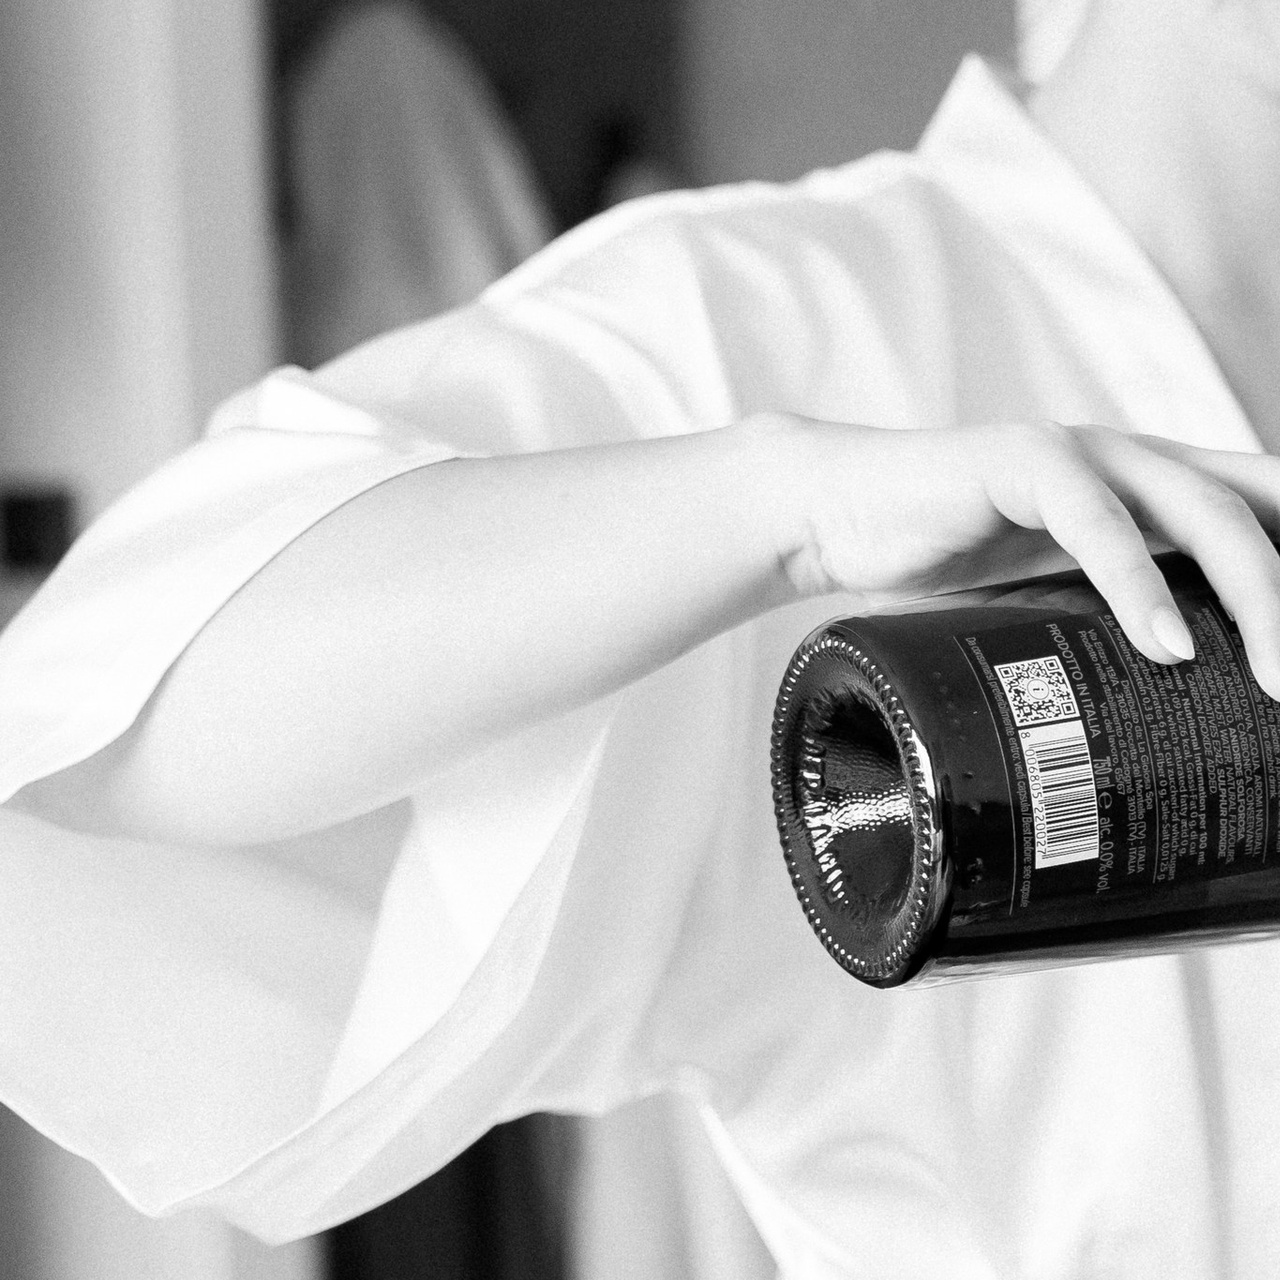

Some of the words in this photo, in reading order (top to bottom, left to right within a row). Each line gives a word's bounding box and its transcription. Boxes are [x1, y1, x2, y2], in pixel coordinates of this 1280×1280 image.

[964, 636, 979, 645] Da
[1077, 630, 1100, 661] Prodotto
[1086, 628, 1099, 641] Via
[1200, 607, 1234, 661] INGREDIENTI:
[970, 645, 998, 681] consumarsi
[1044, 623, 1083, 681] PRODOTTO
[1092, 641, 1109, 664] Erizzo
[1093, 662, 1109, 683] nello
[1104, 665, 1120, 686] 113/A
[1228, 661, 1246, 697] MOSTO
[1075, 682, 1090, 696] IN
[1120, 679, 1141, 724] Distribuito
[1169, 692, 1182, 709] 109
[987, 681, 1017, 736] preferibilmente
[1080, 698, 1102, 738] ITALIA
[1099, 701, 1110, 717] Via
[1102, 683, 1124, 737] stabilimento
[1114, 692, 1130, 719] 31035
[1184, 672, 1204, 714] CARBON
[1196, 715, 1213, 756] DIOXIDE
[1239, 698, 1254, 732] D'UVA,
[1256, 703, 1266, 717] for
[1265, 707, 1276, 723] the
[1103, 718, 1114, 733] del
[1111, 627, 1149, 695] Proteine-Protein
[1140, 696, 1153, 711] 0,3
[1149, 724, 1166, 778] Fibre-Fiber
[1160, 799, 1170, 841] Sale-Salt
[1133, 724, 1144, 740] da:
[1165, 713, 1180, 744] which
[1174, 710, 1188, 737] kJ/26
[1180, 697, 1200, 750] Nutritional
[1193, 611, 1213, 636] ACIDO
[1222, 674, 1243, 721] ANIDRIDE
[1244, 786, 1254, 855] CONSERVANTI
[1260, 725, 1269, 738] no
[1007, 737, 1021, 761] entro:
[1107, 734, 1119, 766] lavoro,
[1117, 738, 1127, 748] di
[1123, 720, 1139, 760] Crocetta
[1136, 741, 1147, 752] La
[1162, 739, 1172, 750] di
[1180, 738, 1193, 761] kcal,
[1190, 664, 1219, 738] PRESERVATIVES
[1215, 767, 1227, 817] SULPHUR
[1200, 665, 1218, 697] GRAPE
[1210, 697, 1226, 727] MUST,
[1218, 728, 1232, 764] WATER,
[1225, 765, 1236, 812] NATURAL
[1228, 726, 1243, 777] ANIDRIDE
[1092, 755, 1113, 775] 750
[1164, 751, 1174, 767] cui
[1246, 732, 1260, 773] ACQUA,
[1263, 739, 1275, 774] alcohol
[1013, 761, 1026, 780] vedi
[1095, 775, 1115, 789] ml
[1113, 767, 1125, 796] 65/67
[1131, 761, 1141, 777] del
[1139, 754, 1152, 790] Gioiosa
[1172, 745, 1187, 792] saturated
[1193, 752, 1207, 811] Information
[1134, 778, 1145, 819] Montello
[1185, 761, 1198, 810] Grassi-Fat
[1252, 773, 1263, 807] AROMI
[1024, 749, 1042, 798] 006805
[1033, 806, 1047, 855] 220027
[1126, 794, 1136, 821] 31013
[1142, 790, 1155, 810] Spa
[1178, 793, 1188, 817] fatty
[1099, 815, 1113, 838] alc.
[1126, 821, 1136, 841] (TV)
[1136, 820, 1146, 840] (TV)
[1180, 818, 1189, 838] acid
[1189, 830, 1197, 840] di
[1197, 813, 1205, 830] per
[1023, 834, 1033, 864] before:
[1170, 822, 1180, 851] which
[1189, 840, 1197, 855] cui
[1198, 831, 1207, 849] 100
[1099, 840, 1114, 872] 0.0%
[1127, 846, 1136, 875] ITALIA
[1136, 845, 1145, 873] ITALIA
[1167, 852, 1177, 881] sugars
[1022, 864, 1031, 879] see
[1096, 872, 1110, 894] vol.
